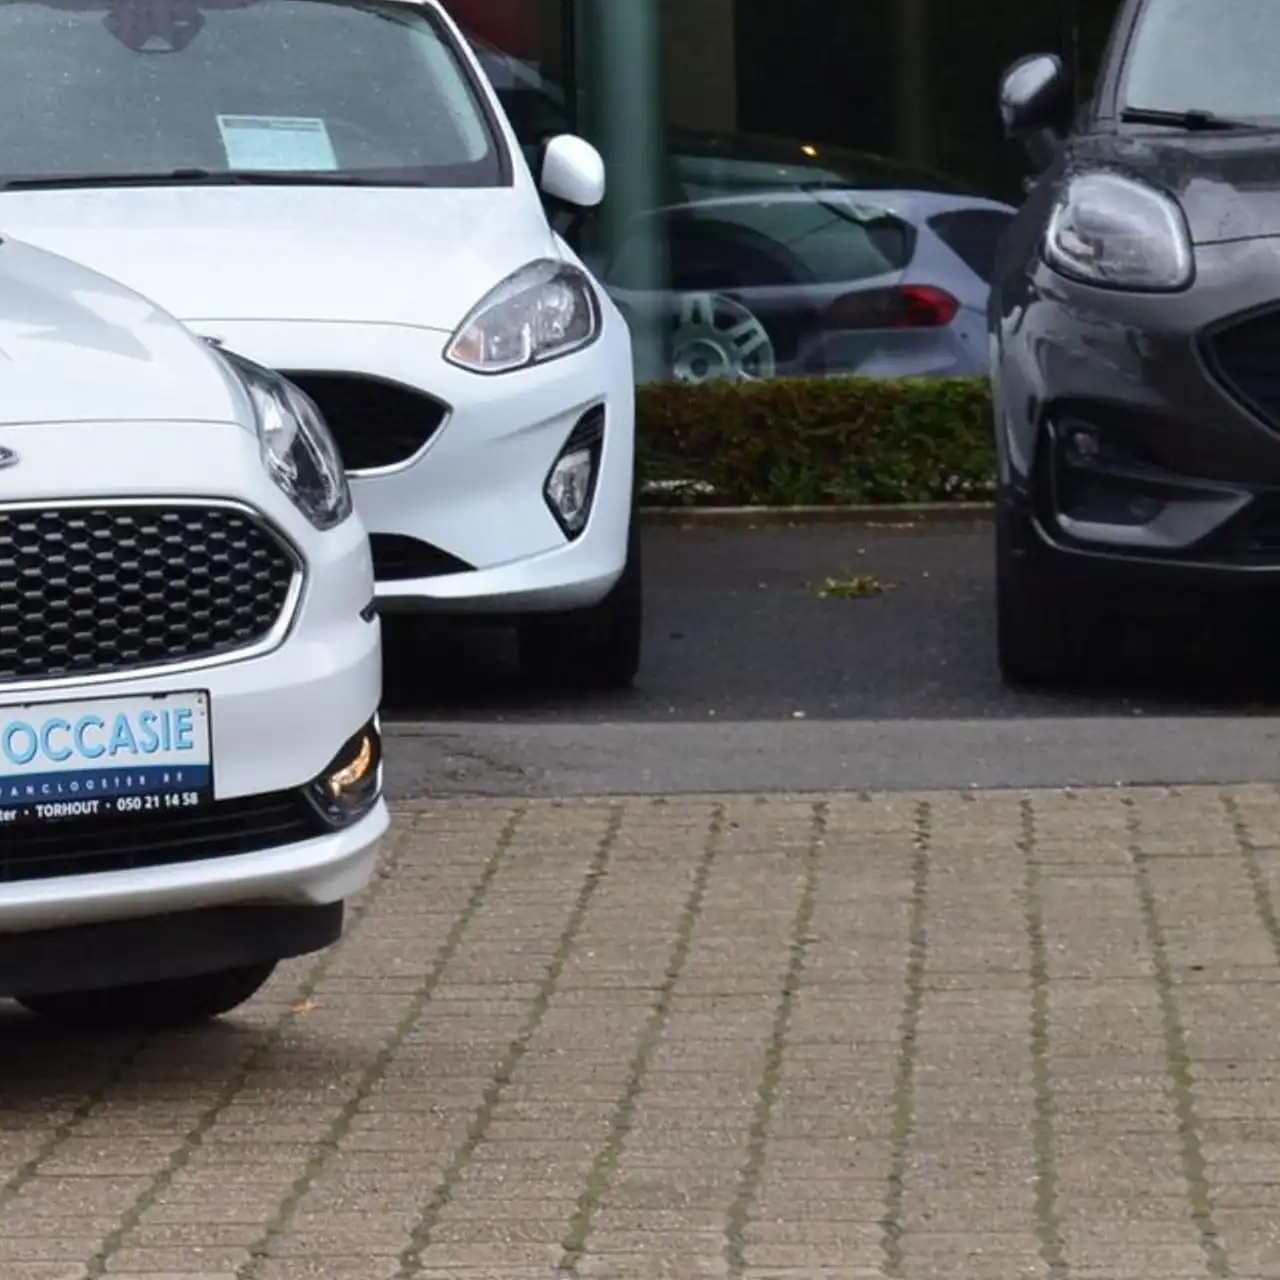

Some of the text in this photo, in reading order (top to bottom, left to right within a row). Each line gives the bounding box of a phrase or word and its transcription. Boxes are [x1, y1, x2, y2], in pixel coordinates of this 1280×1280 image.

[2, 707, 194, 765] OCCASIE
[35, 800, 100, 818] TORHOUT
[116, 796, 141, 811] 050
[144, 795, 159, 810] 21
[164, 793, 179, 807] 14
[182, 792, 199, 806] 58
